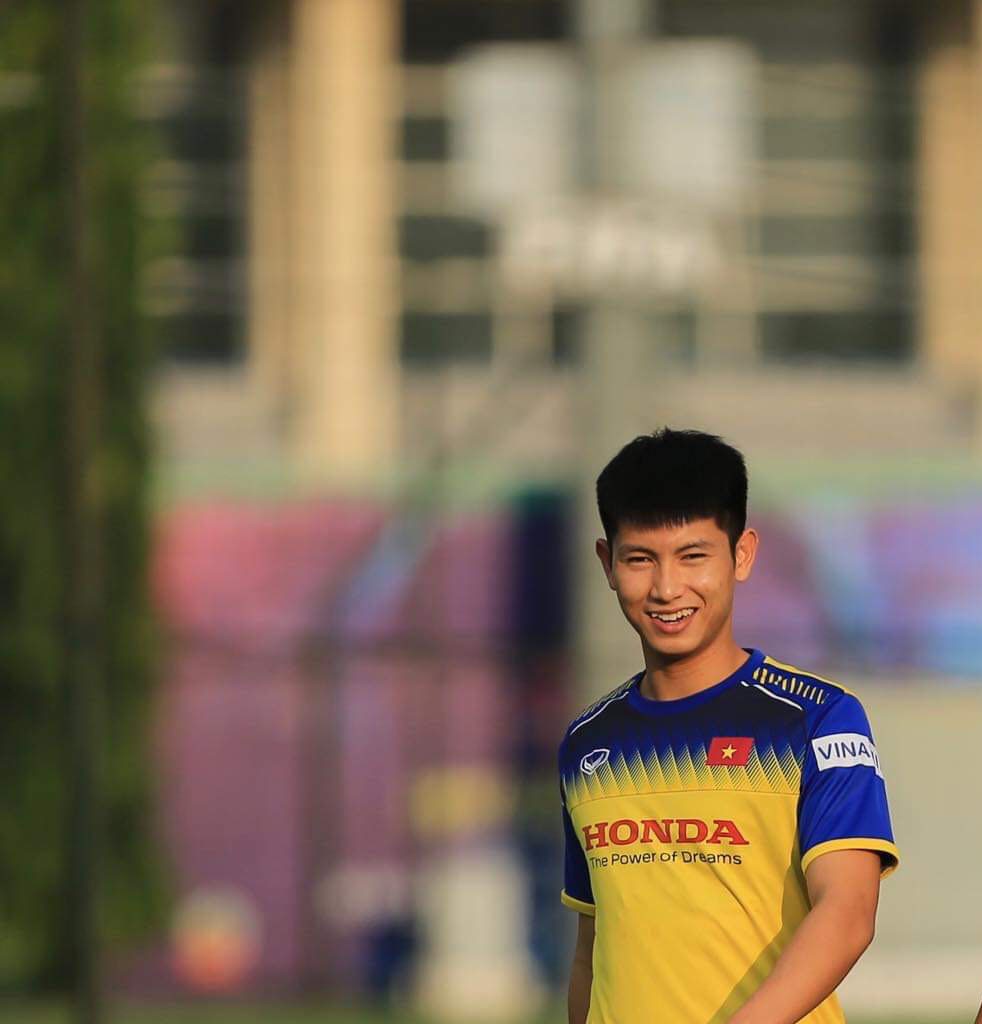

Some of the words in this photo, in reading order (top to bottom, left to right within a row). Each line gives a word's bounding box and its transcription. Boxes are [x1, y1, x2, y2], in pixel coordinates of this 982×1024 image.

[582, 819, 750, 850] HONDA
[611, 852, 657, 866] Power
[660, 851, 678, 862] of
[681, 851, 742, 865] Dreams
